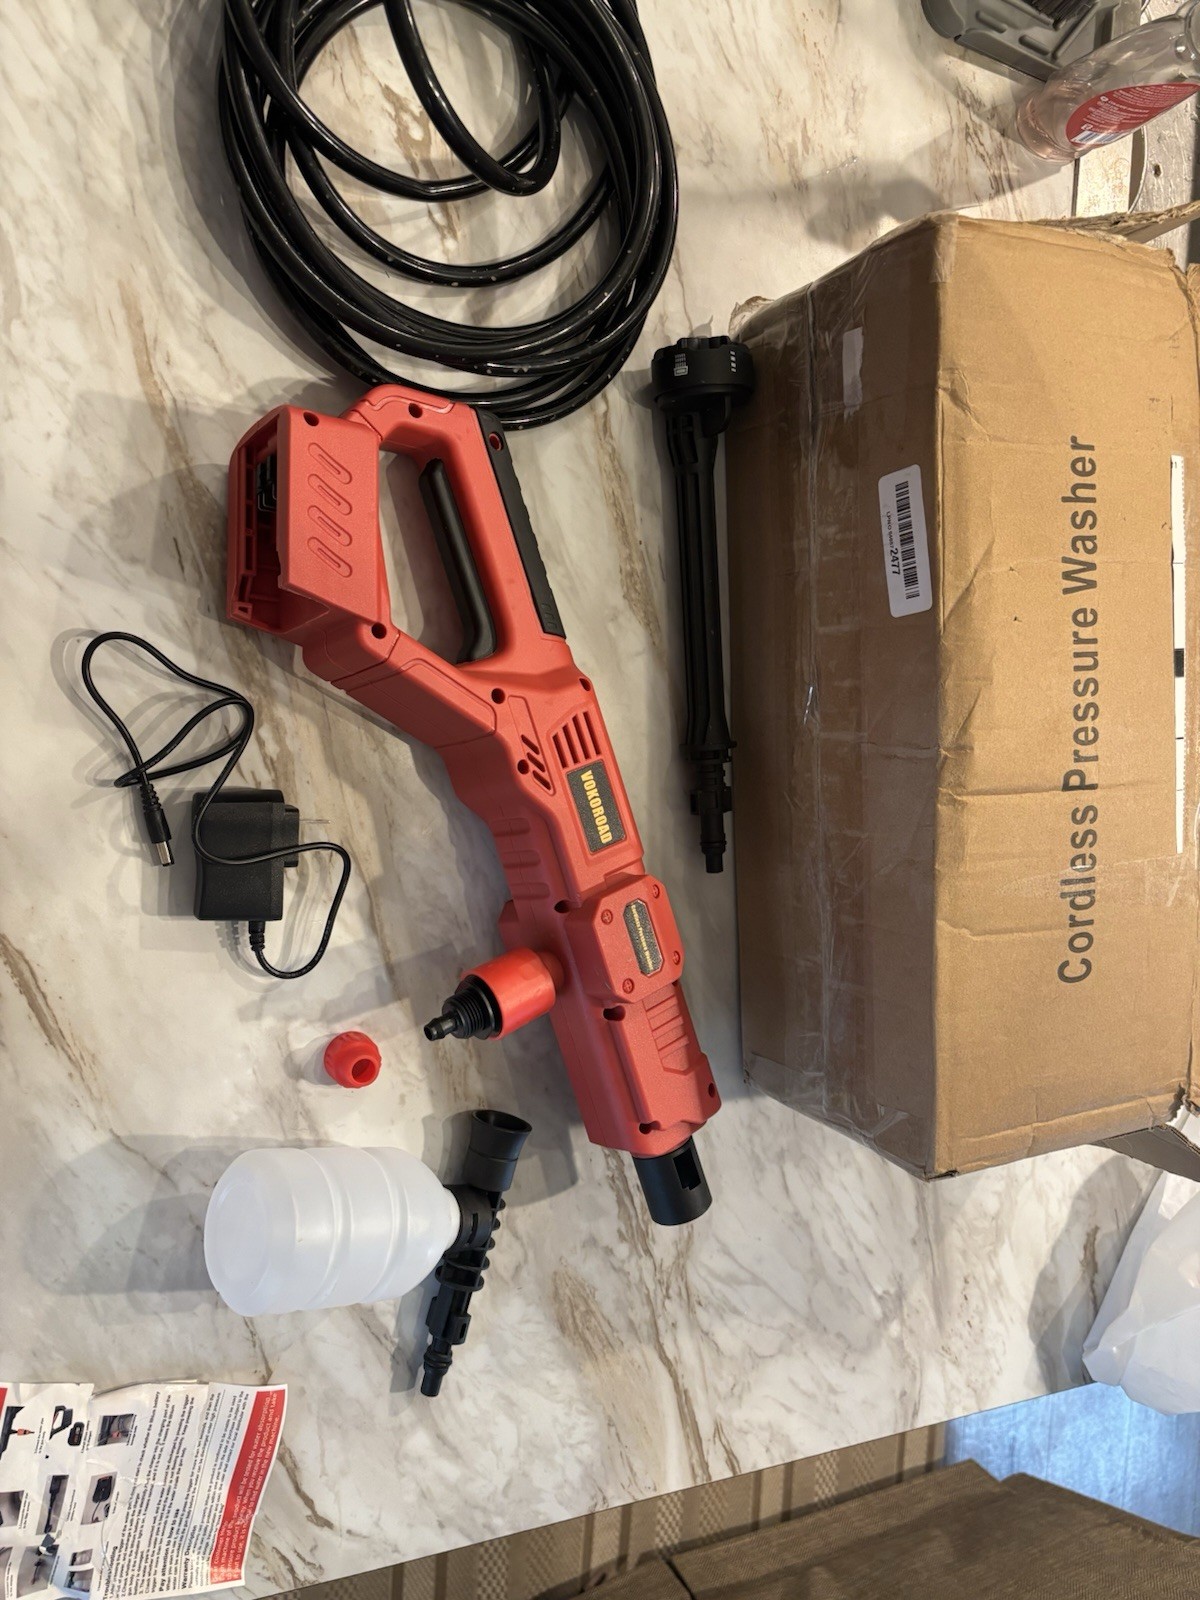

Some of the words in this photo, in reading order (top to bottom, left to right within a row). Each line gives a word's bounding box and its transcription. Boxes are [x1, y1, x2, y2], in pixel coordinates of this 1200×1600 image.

[1060, 436, 1097, 594] Washer
[1060, 607, 1100, 792] Pressure
[580, 770, 613, 844] VOKOROAD
[1056, 804, 1100, 984] Cordless
